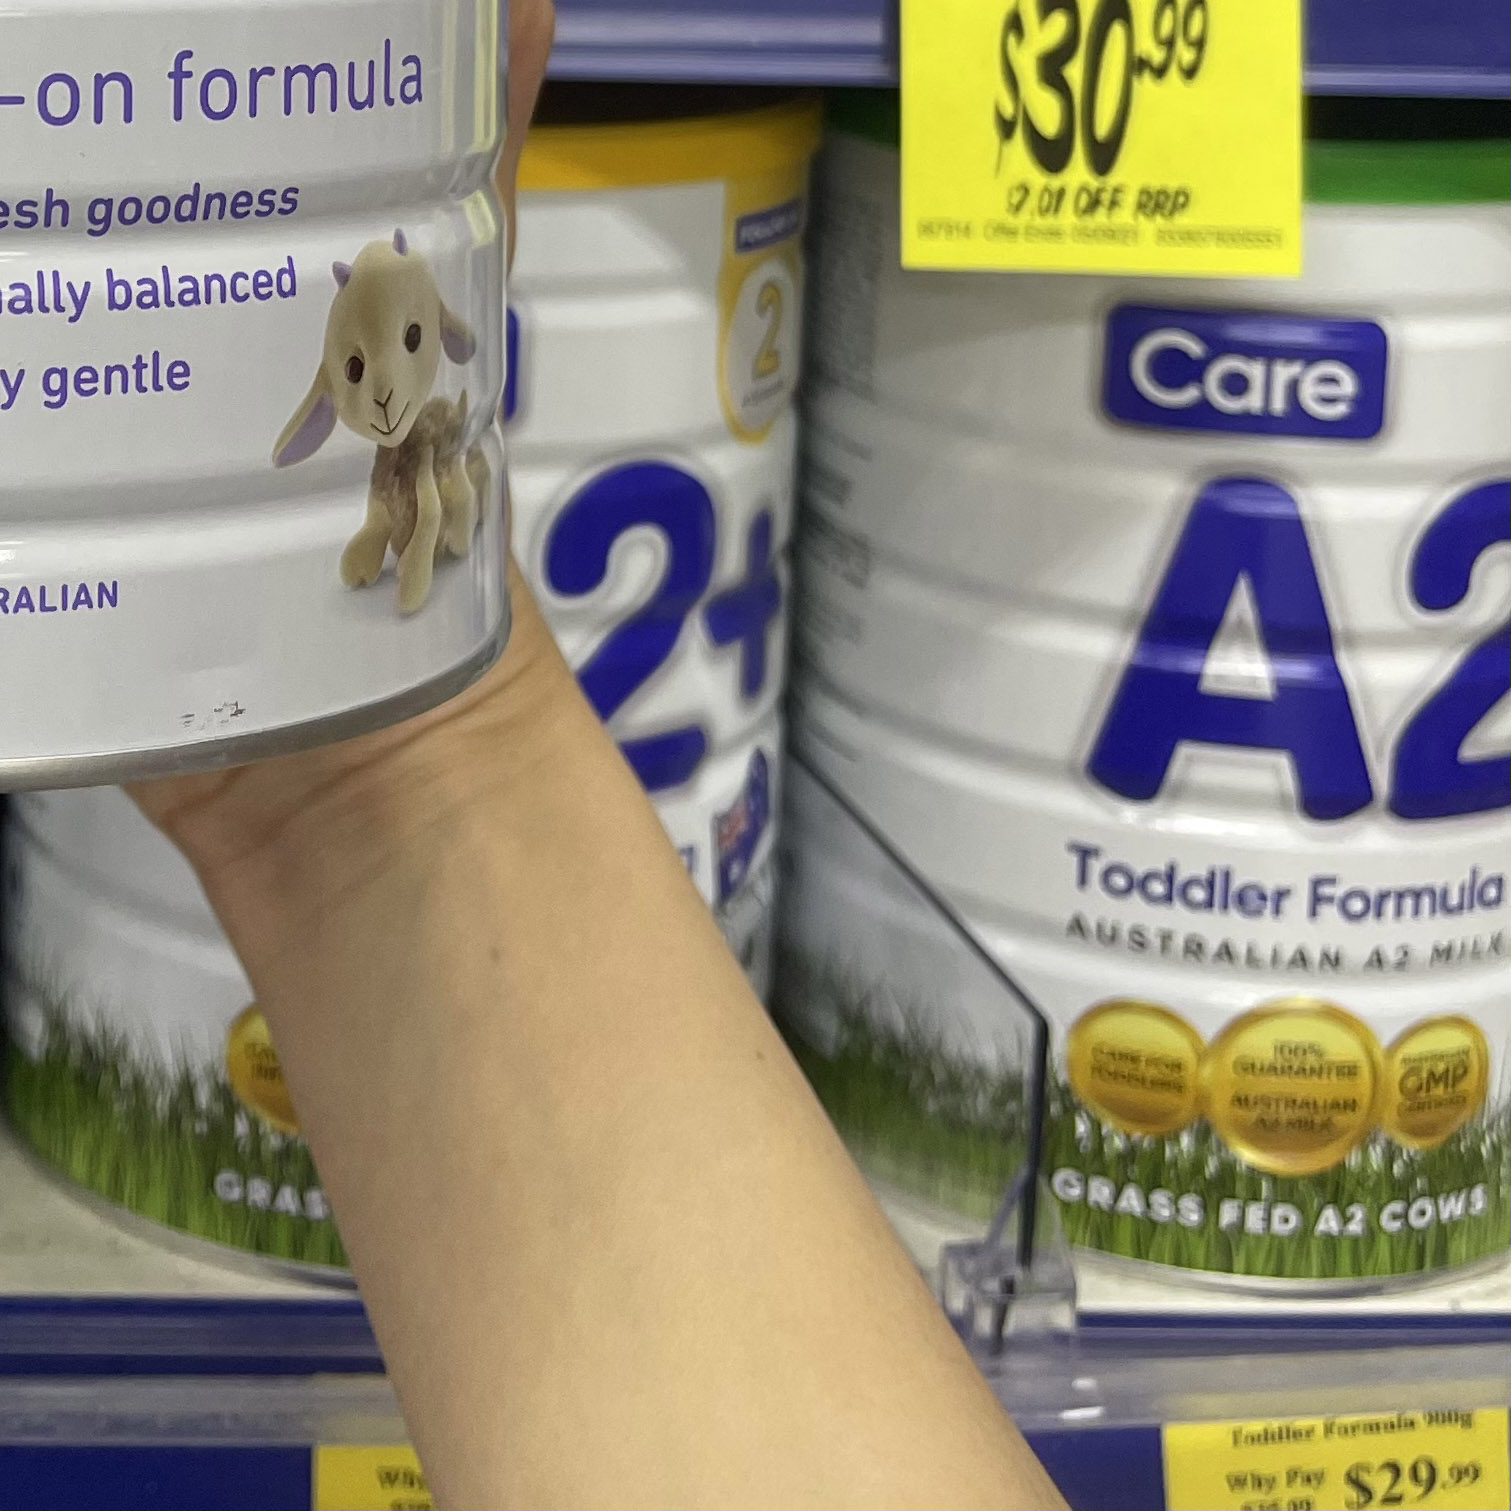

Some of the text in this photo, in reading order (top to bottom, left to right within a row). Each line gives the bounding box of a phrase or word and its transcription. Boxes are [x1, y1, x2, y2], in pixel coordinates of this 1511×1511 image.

[168, 39, 425, 123] formula
[86, 179, 301, 238] goodness
[1073, 185, 1191, 221] OFF RRP
[106, 257, 298, 314] balanced
[753, 279, 783, 381] 2
[39, 349, 192, 401] gentle
[1129, 327, 1360, 423] Care
[1066, 840, 1505, 925] Toddler Formula
[1064, 912, 1509, 974] AUSTRALIAN A2 MILK
[1232, 1055, 1359, 1079] GUARANTEE
[1398, 1058, 1470, 1096] GMP
[1230, 1091, 1359, 1115] AUSTRALIAN
[1050, 1167, 1489, 1238] GRASS FED A2 COWS
[1323, 1412, 1416, 1438] Formula
[1225, 1471, 1277, 1496] Why
[1285, 1466, 1326, 1493] Pay
[1343, 1454, 1482, 1511] $29.99
